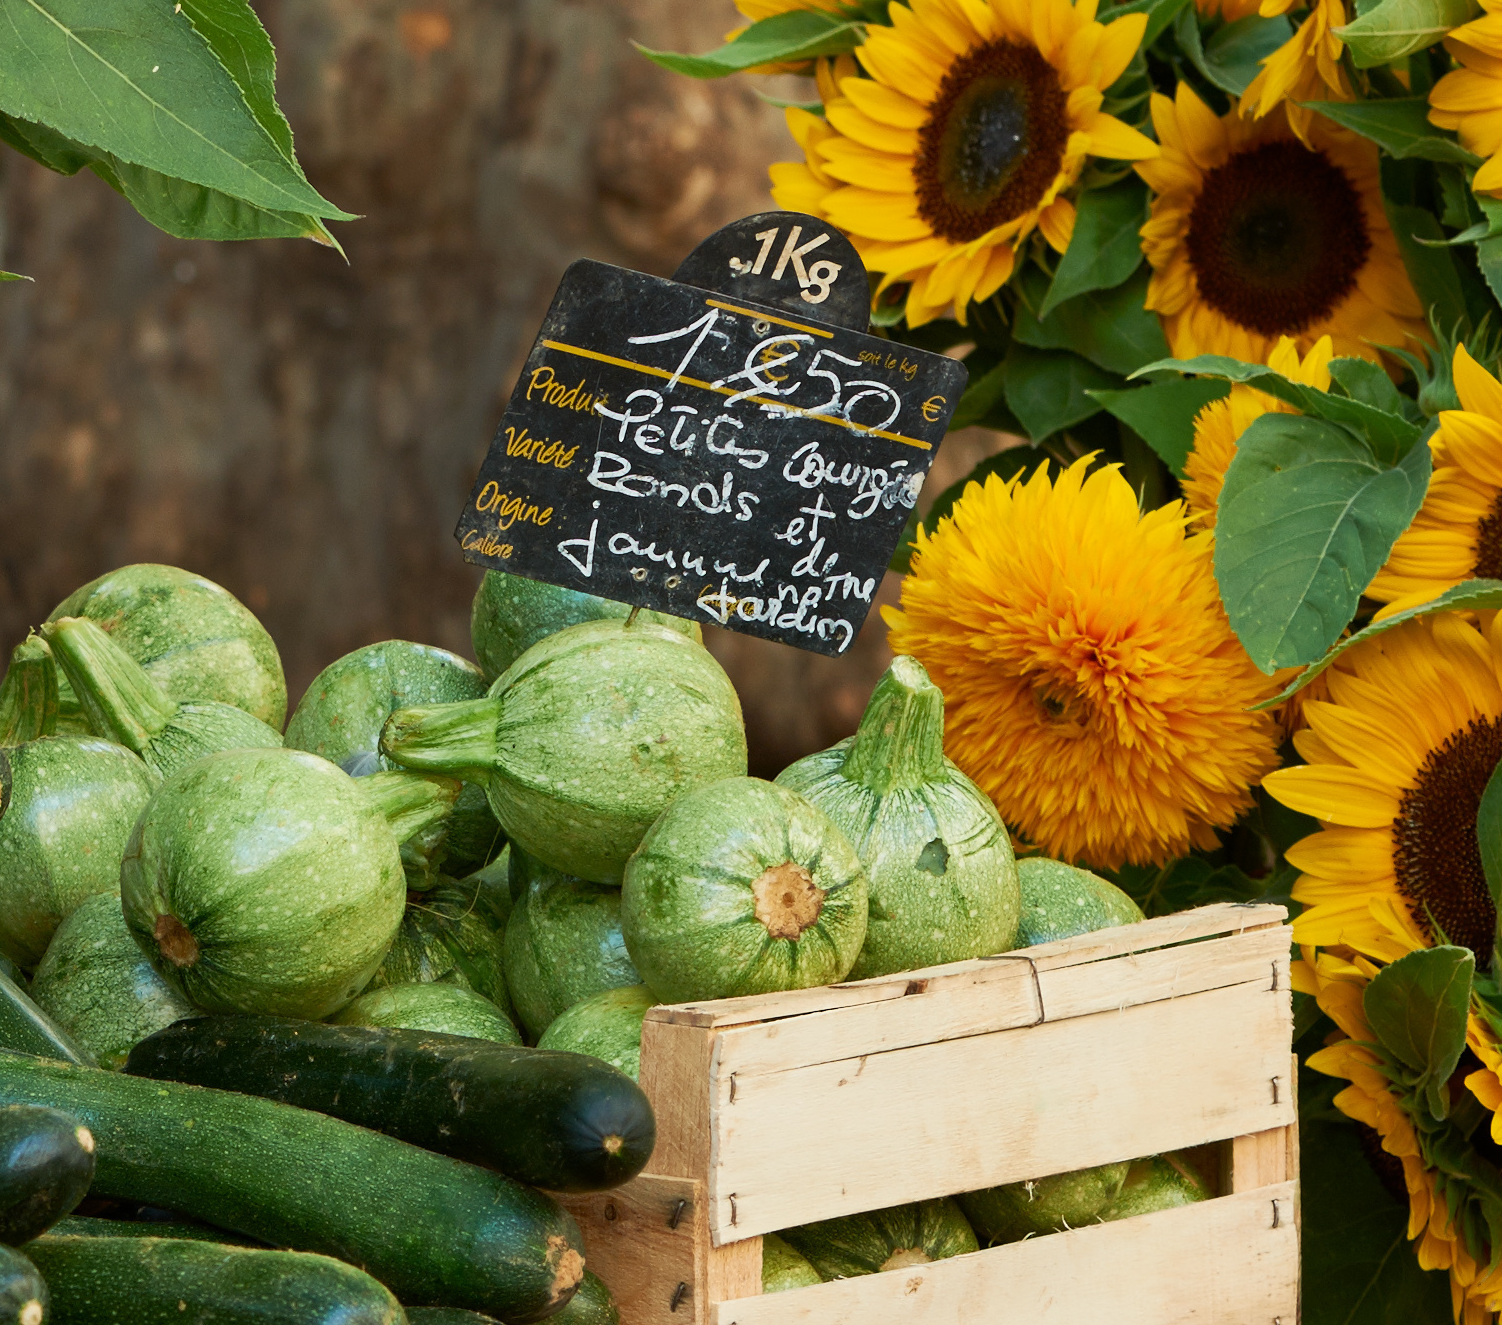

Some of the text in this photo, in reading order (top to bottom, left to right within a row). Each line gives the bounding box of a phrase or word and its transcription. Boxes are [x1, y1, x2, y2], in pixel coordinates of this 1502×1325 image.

[857, 350, 918, 382] soit le kg
[475, 480, 554, 531] Origine
[773, 492, 837, 546] et
